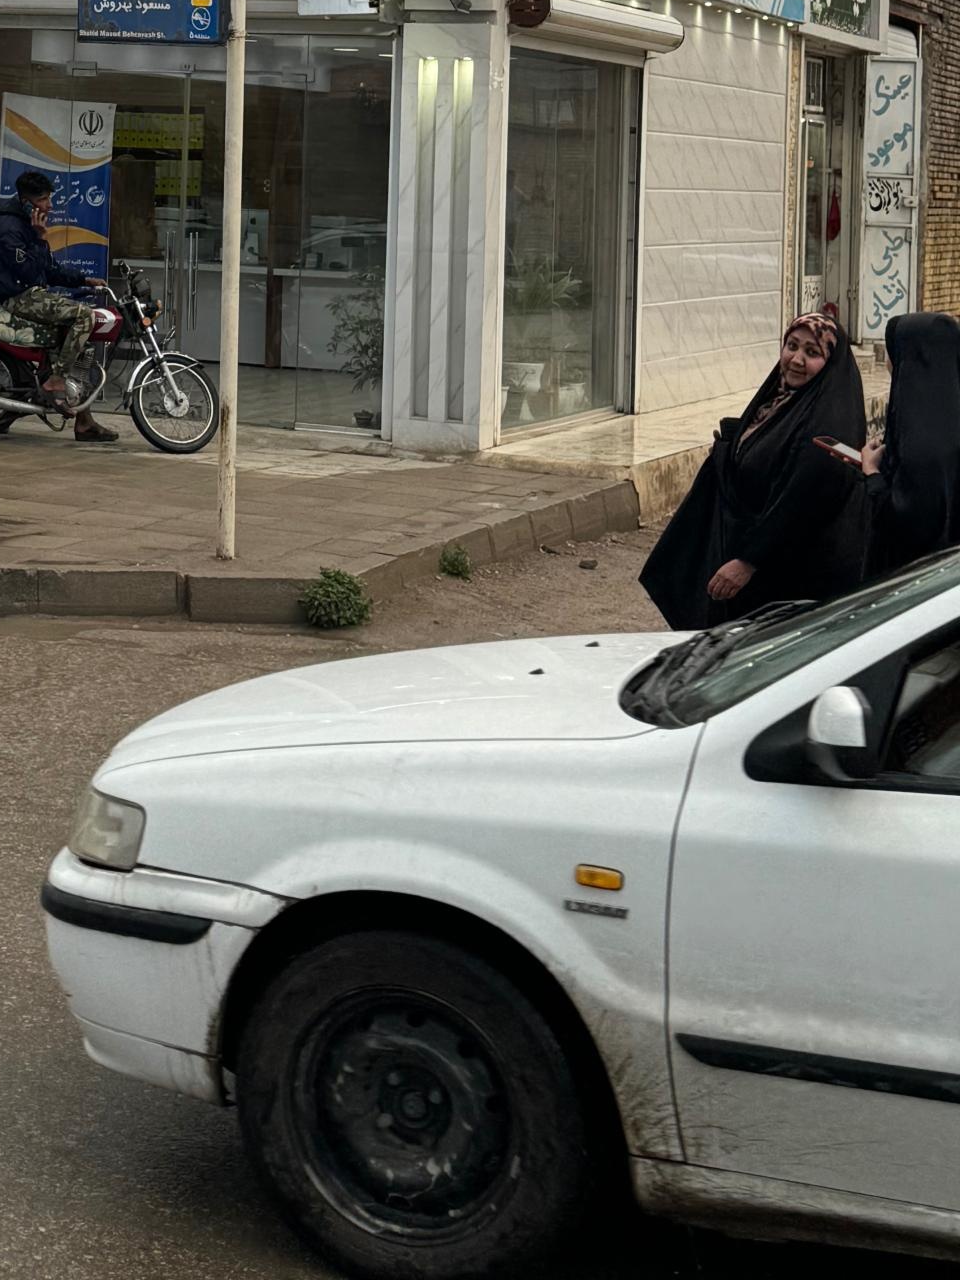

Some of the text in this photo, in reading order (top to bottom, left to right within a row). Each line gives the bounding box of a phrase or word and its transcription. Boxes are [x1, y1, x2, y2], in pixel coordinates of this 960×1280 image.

[135, 0, 171, 14] مسعود
[872, 74, 912, 116] عینک
[867, 123, 913, 167] موعود
[872, 230, 904, 276] طبی
